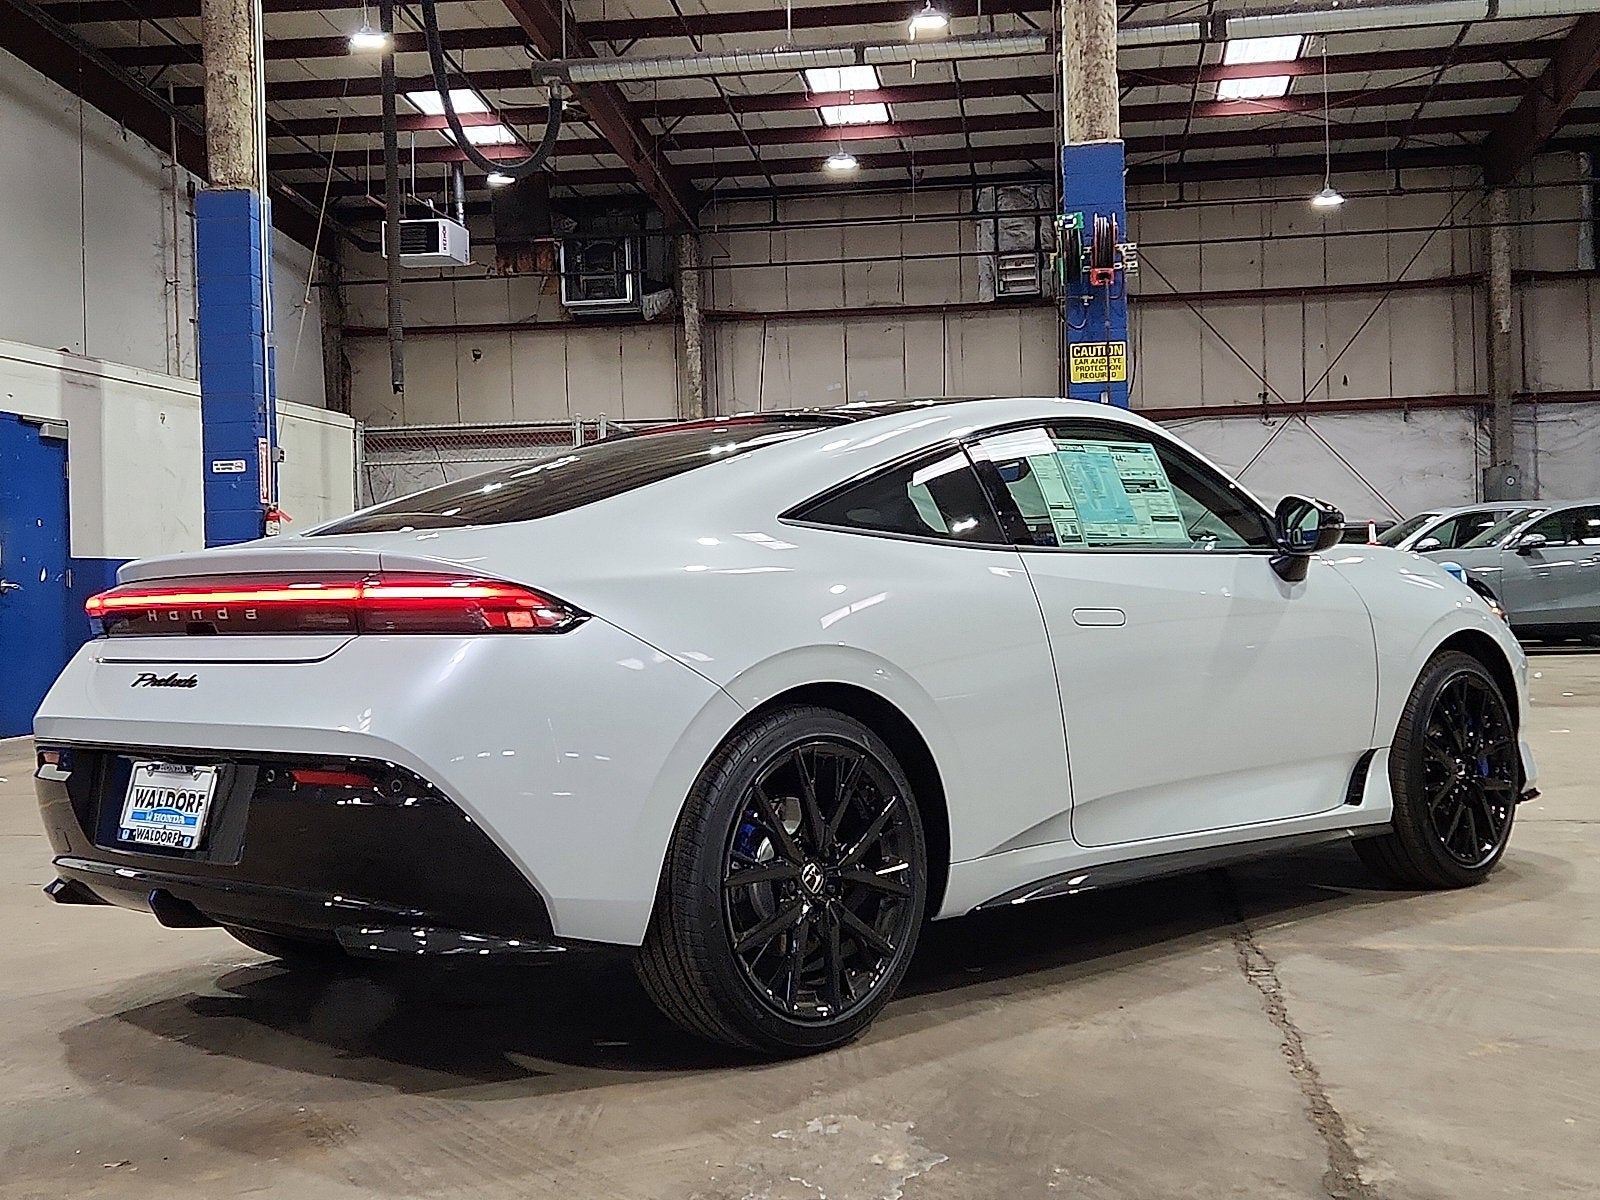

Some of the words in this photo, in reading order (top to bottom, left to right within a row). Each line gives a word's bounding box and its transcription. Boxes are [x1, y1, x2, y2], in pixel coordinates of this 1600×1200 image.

[1075, 364, 1121, 372] PROTECTON
[1080, 371, 1117, 379] REQUIRD
[130, 672, 198, 689] Prelude
[158, 763, 188, 773] HONDA
[133, 788, 206, 814] WALDORF
[153, 813, 186, 824] HONDA
[136, 827, 179, 845] WALDORF
